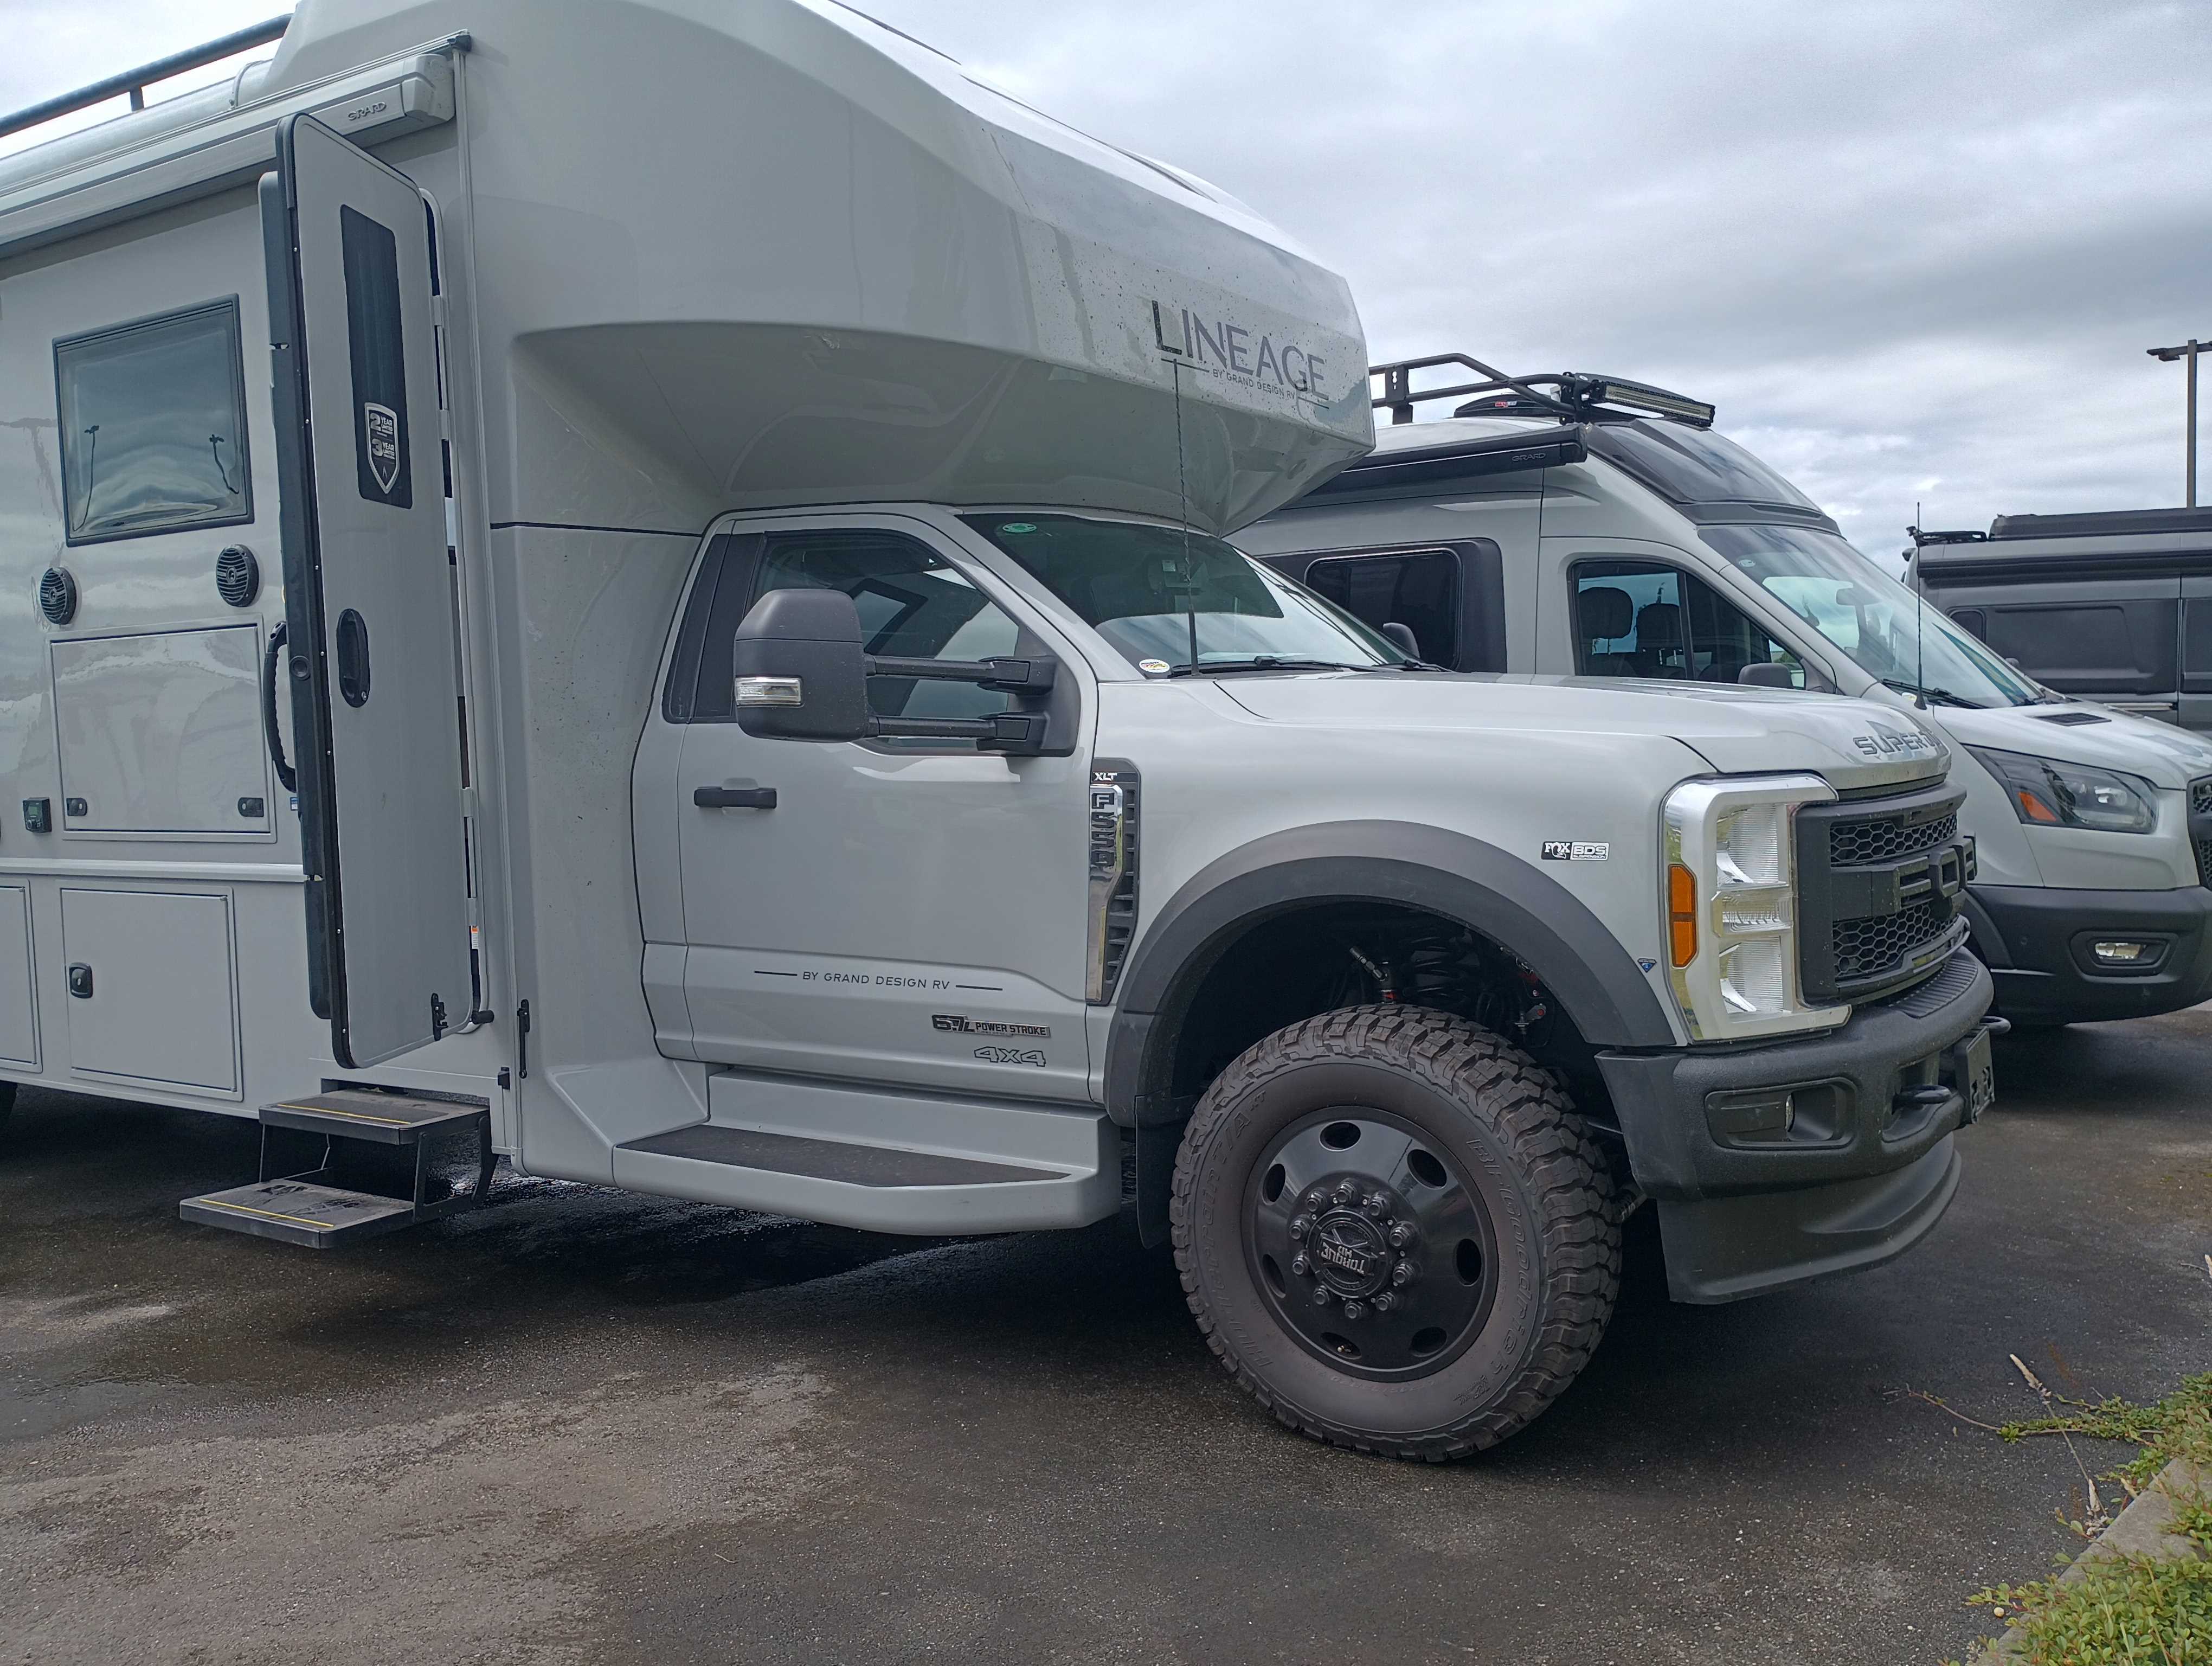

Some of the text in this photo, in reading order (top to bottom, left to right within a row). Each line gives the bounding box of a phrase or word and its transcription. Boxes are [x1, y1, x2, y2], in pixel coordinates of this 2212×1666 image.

[1151, 300, 1330, 401] LINEAGE
[1212, 369, 1295, 400] BY GRAND DESIGN RV
[370, 412, 393, 431] 2 YEAR
[372, 438, 395, 457] 3 YEAR
[1853, 733, 1928, 755] SUPER
[1094, 772, 1117, 781] XLT
[1545, 842, 1571, 858] FOX
[1573, 845, 1606, 855] BDS
[803, 971, 949, 990] BY GRAND DESIGN RV
[931, 1013, 975, 1032] 6.7L
[976, 1022, 1007, 1031] POWER
[1009, 1025, 1046, 1035] STROKE
[1321, 1241, 1365, 1275] TORQUE
